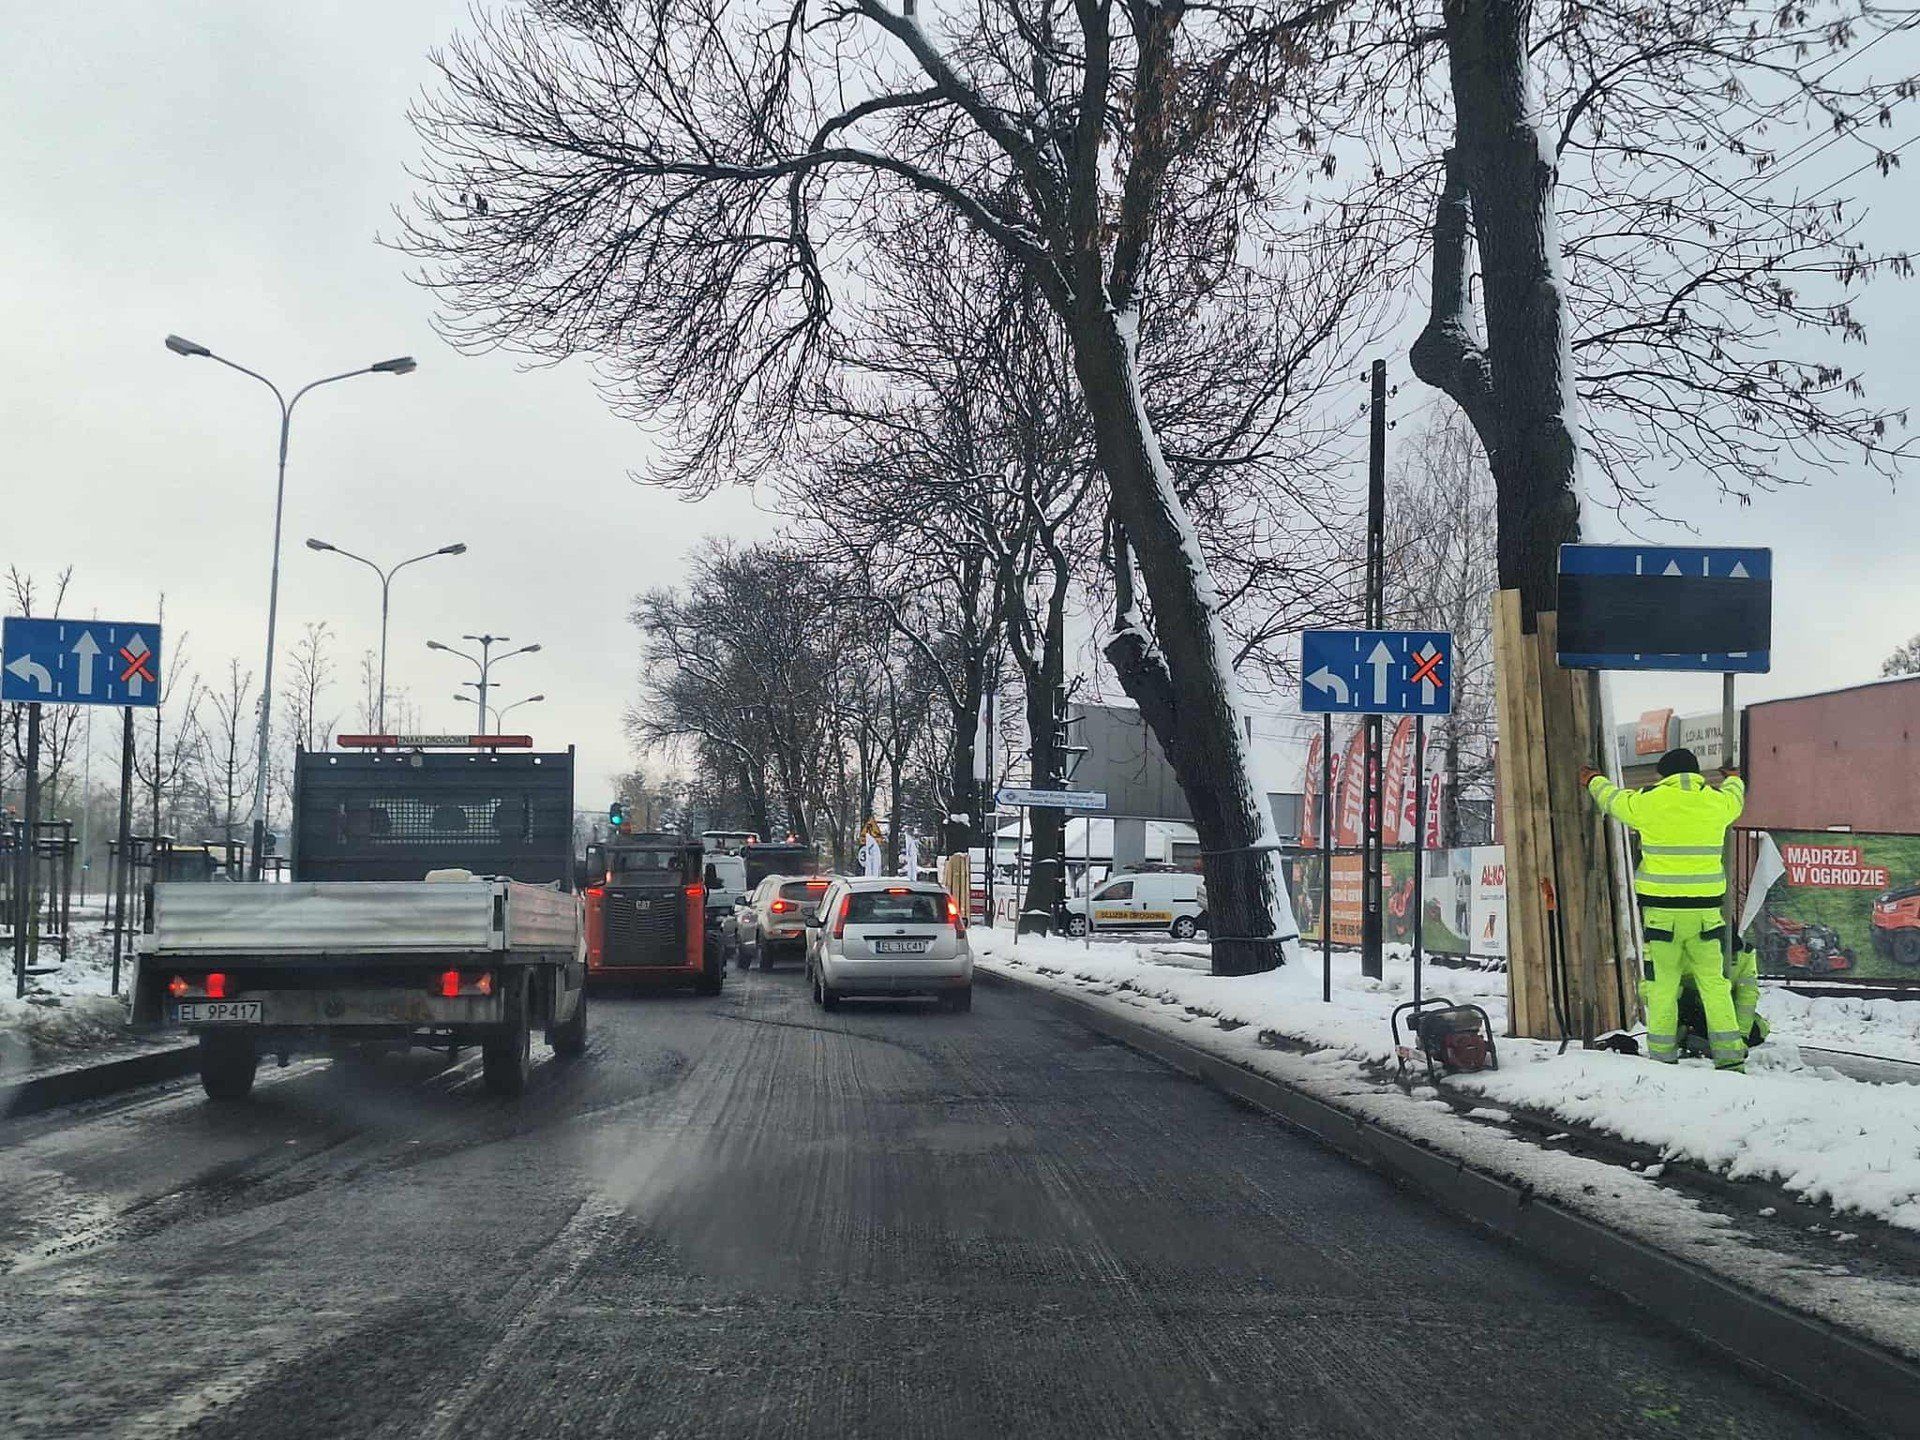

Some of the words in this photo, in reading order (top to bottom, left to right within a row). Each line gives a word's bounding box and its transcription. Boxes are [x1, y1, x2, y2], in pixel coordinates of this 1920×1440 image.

[1788, 848, 1857, 868] MĄDRZEJ
[1792, 867, 1807, 883] W
[1811, 868, 1885, 886] OGRODZIE
[181, 1005, 200, 1020] EL
[208, 1004, 258, 1020] 9P417
